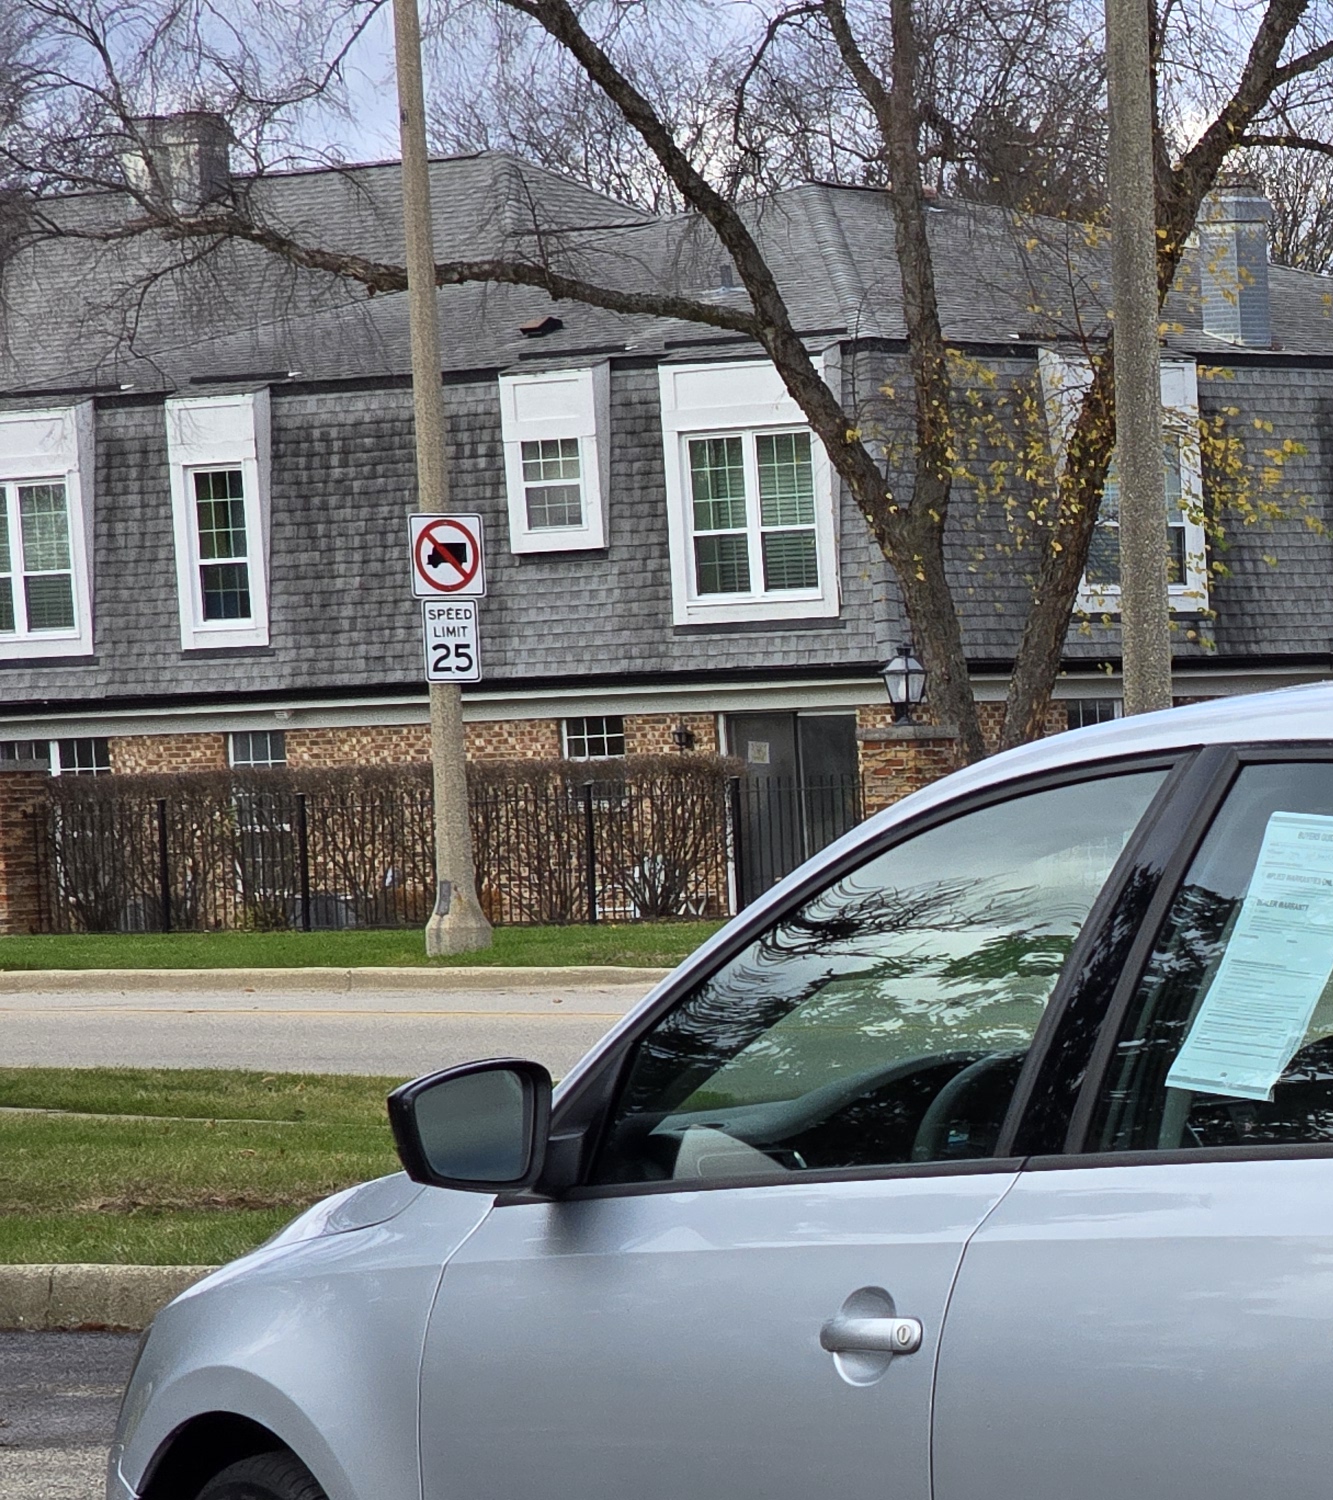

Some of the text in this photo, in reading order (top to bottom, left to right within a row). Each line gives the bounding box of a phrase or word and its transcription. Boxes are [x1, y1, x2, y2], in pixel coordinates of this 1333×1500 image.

[428, 608, 472, 620] SPEED
[433, 625, 468, 638] LIMIT
[432, 643, 473, 672] 25
